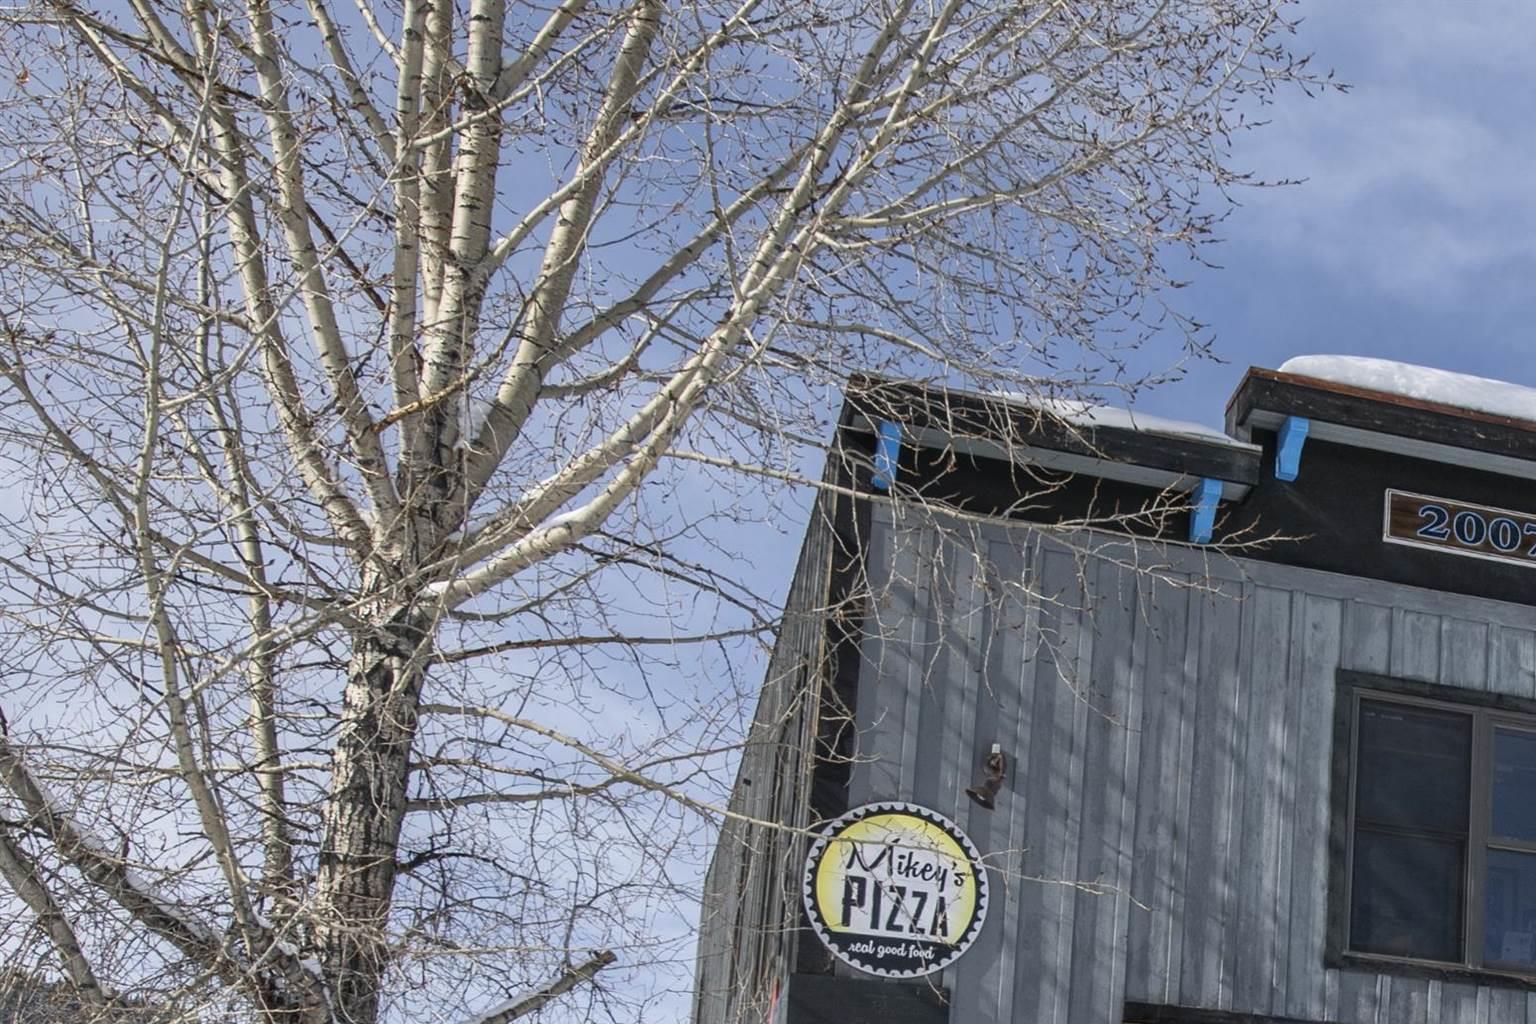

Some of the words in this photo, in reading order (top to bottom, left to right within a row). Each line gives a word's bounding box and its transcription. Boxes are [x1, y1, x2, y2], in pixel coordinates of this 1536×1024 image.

[846, 837, 966, 893] Mikey's
[841, 876, 949, 937] PIZZA
[848, 940, 875, 954] real
[877, 943, 907, 958] good
[909, 944, 936, 960] food
